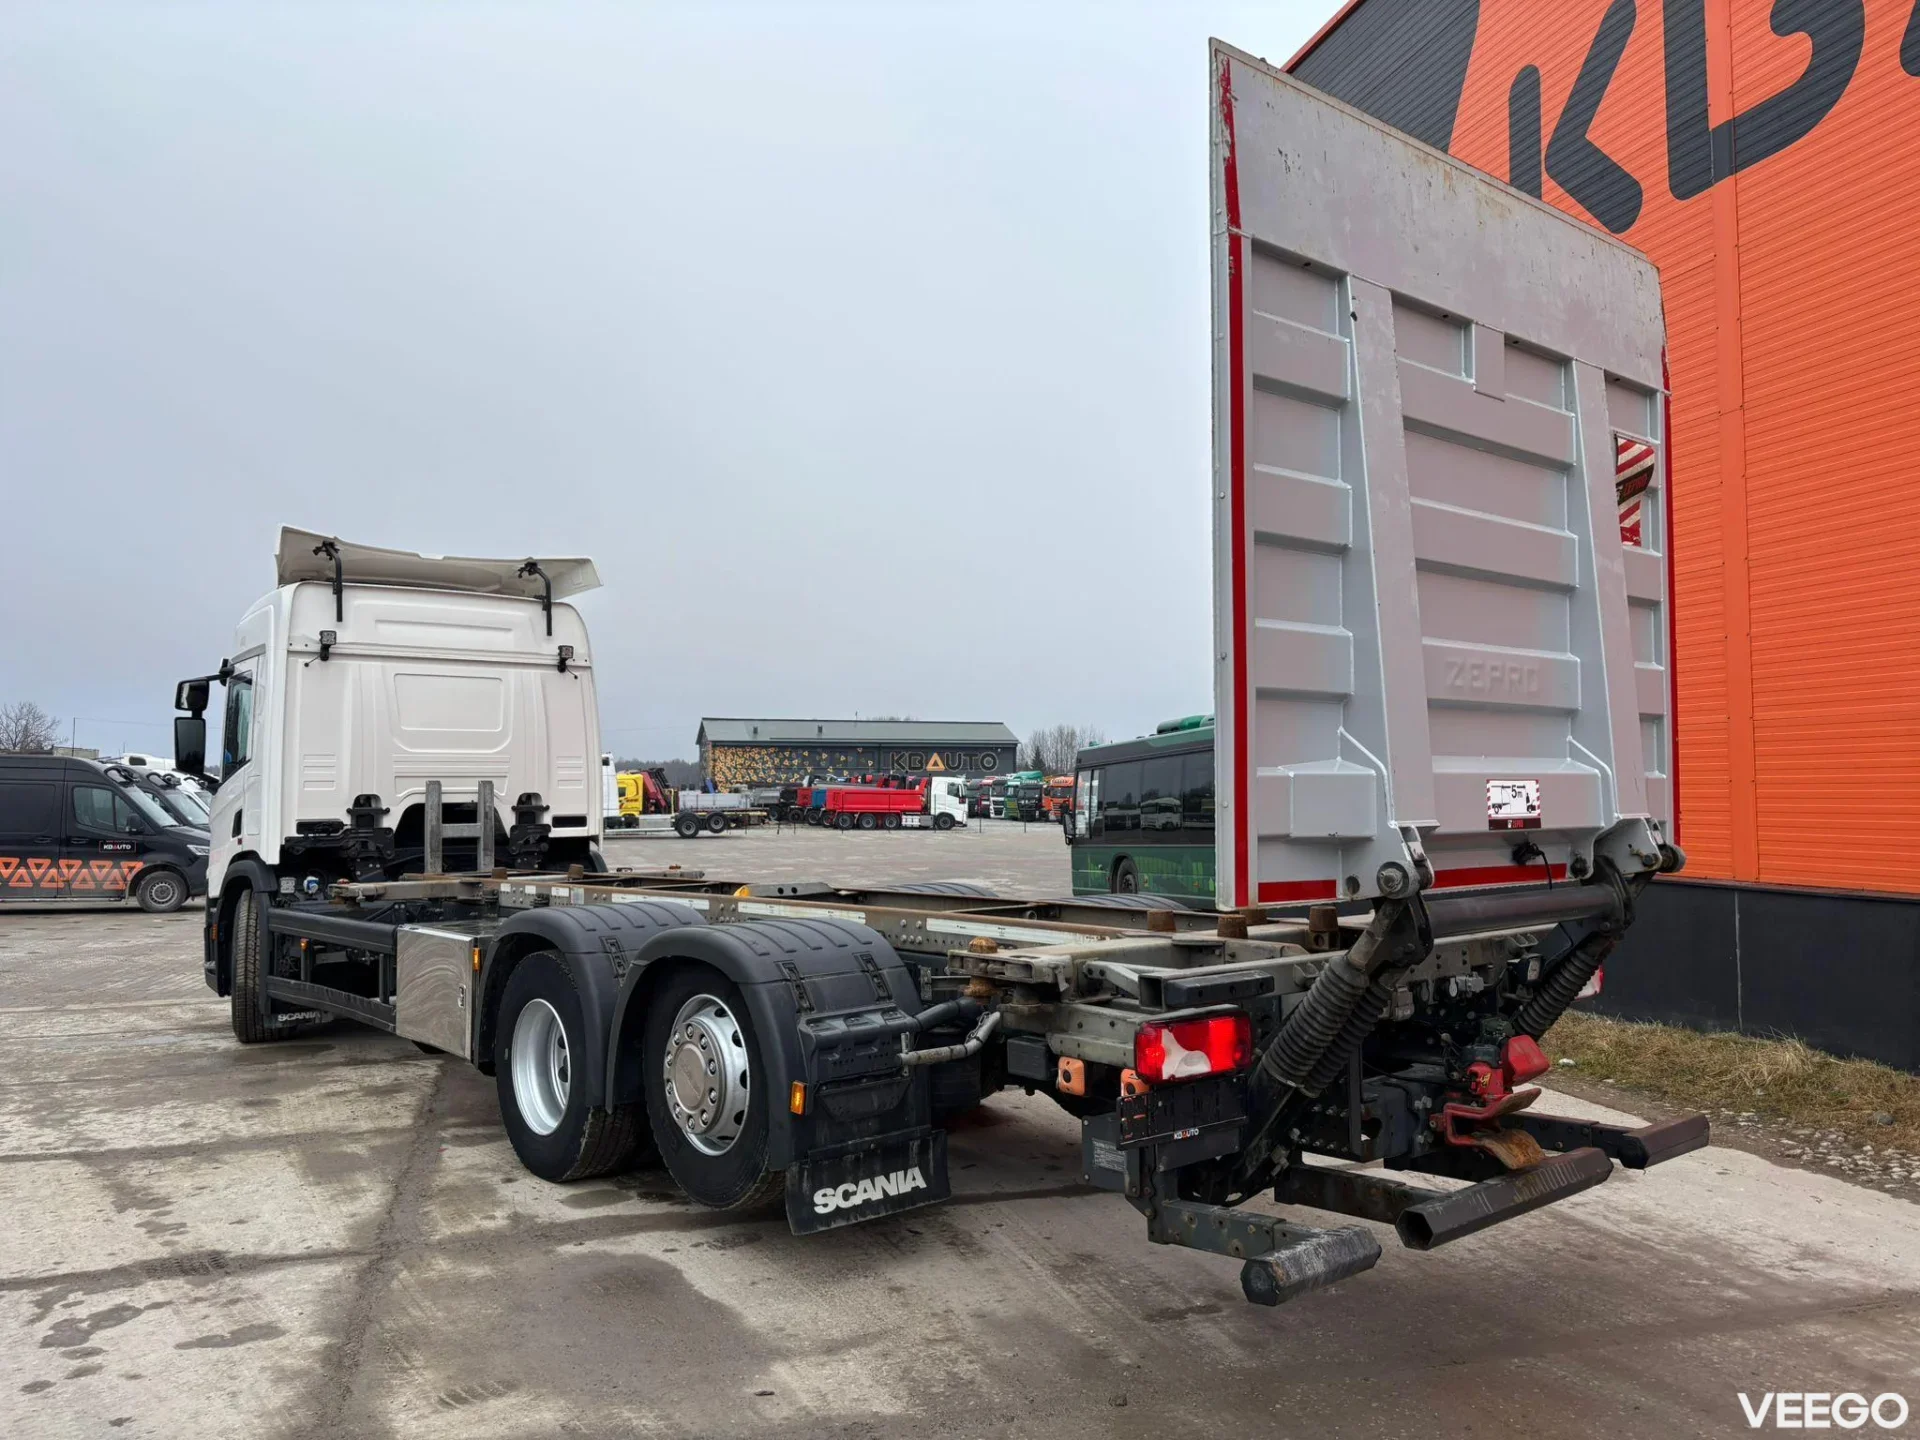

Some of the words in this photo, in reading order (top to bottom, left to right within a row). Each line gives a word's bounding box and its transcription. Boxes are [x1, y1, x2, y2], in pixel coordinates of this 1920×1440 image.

[1508, 0, 1920, 234] KB
[1444, 657, 1540, 697] ZEPRO
[890, 751, 998, 772] KBAUTO
[278, 1011, 320, 1021] SCANIA
[813, 1166, 927, 1214] SCANIA
